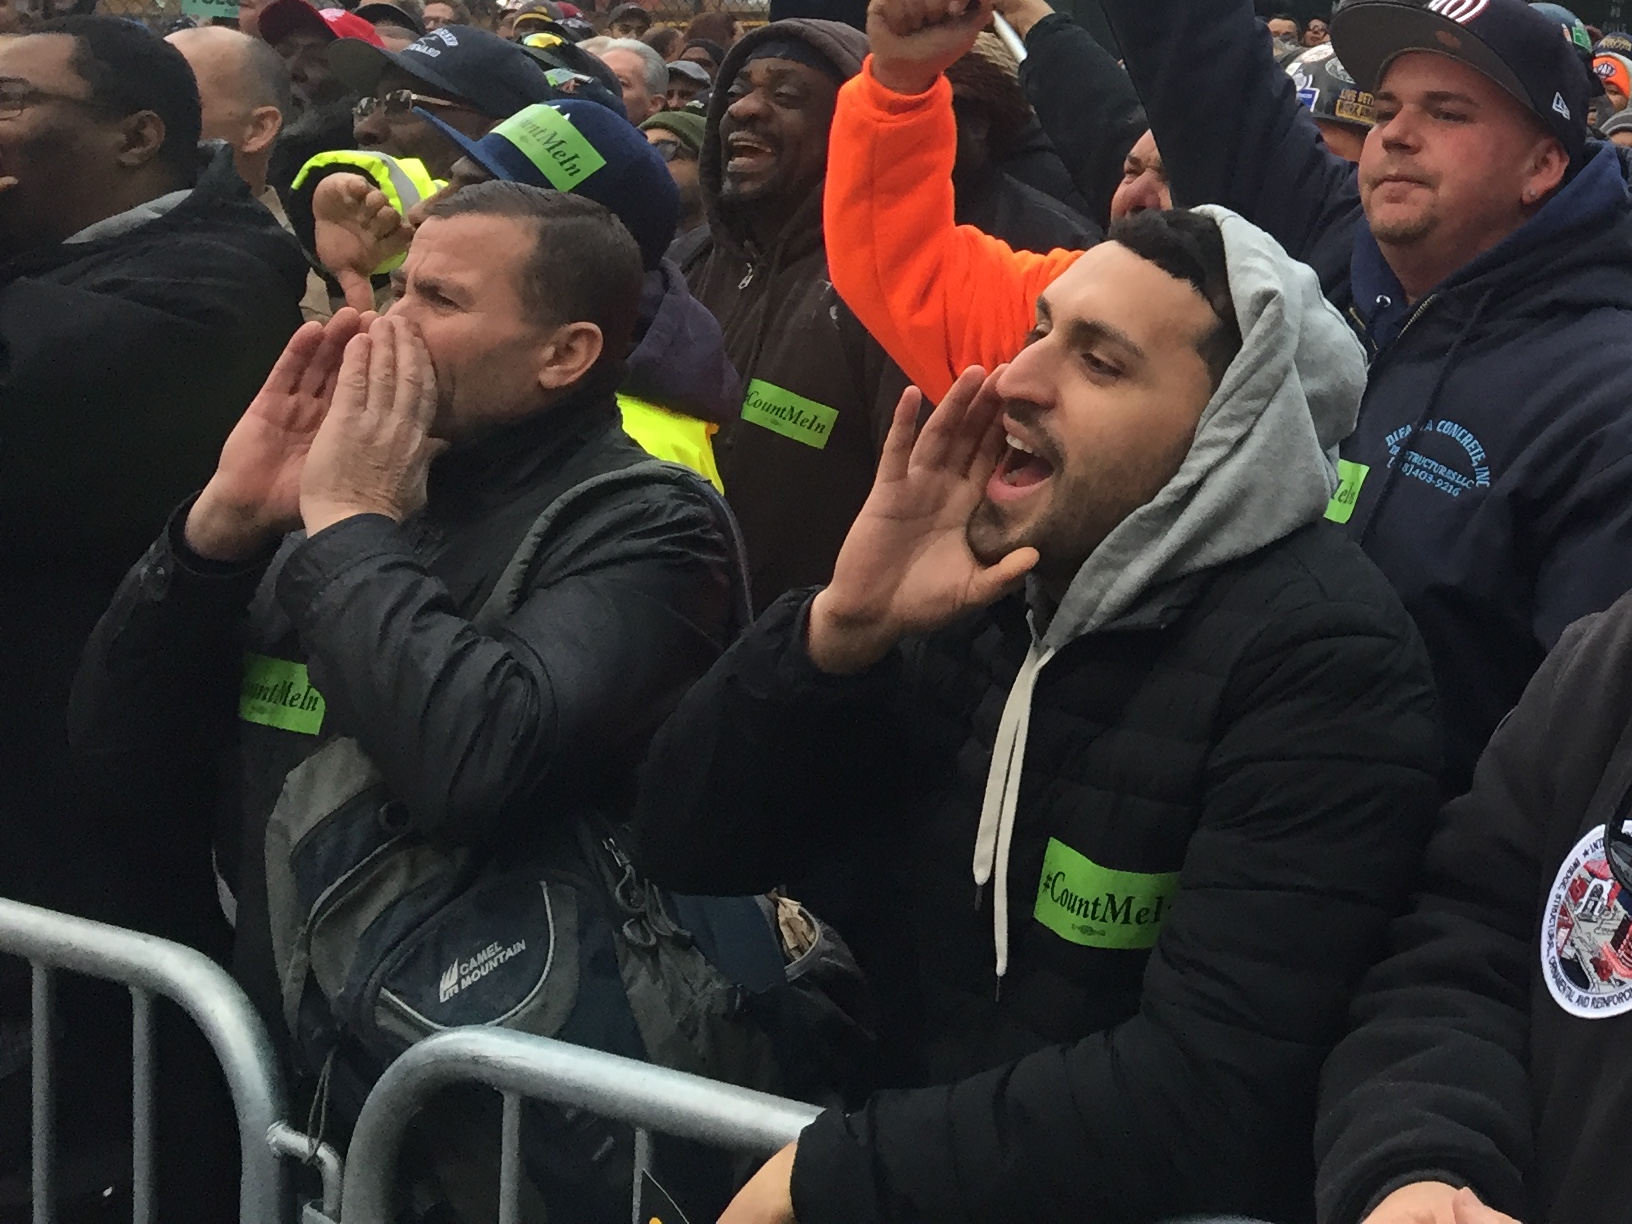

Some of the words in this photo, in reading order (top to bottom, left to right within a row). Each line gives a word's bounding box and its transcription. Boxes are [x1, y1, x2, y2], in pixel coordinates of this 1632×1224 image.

[746, 390, 827, 434] CountMeIn
[1042, 871, 1170, 925] #CountMeI
[460, 941, 502, 975] CAMEL
[461, 939, 526, 989] MOUNTAIN
